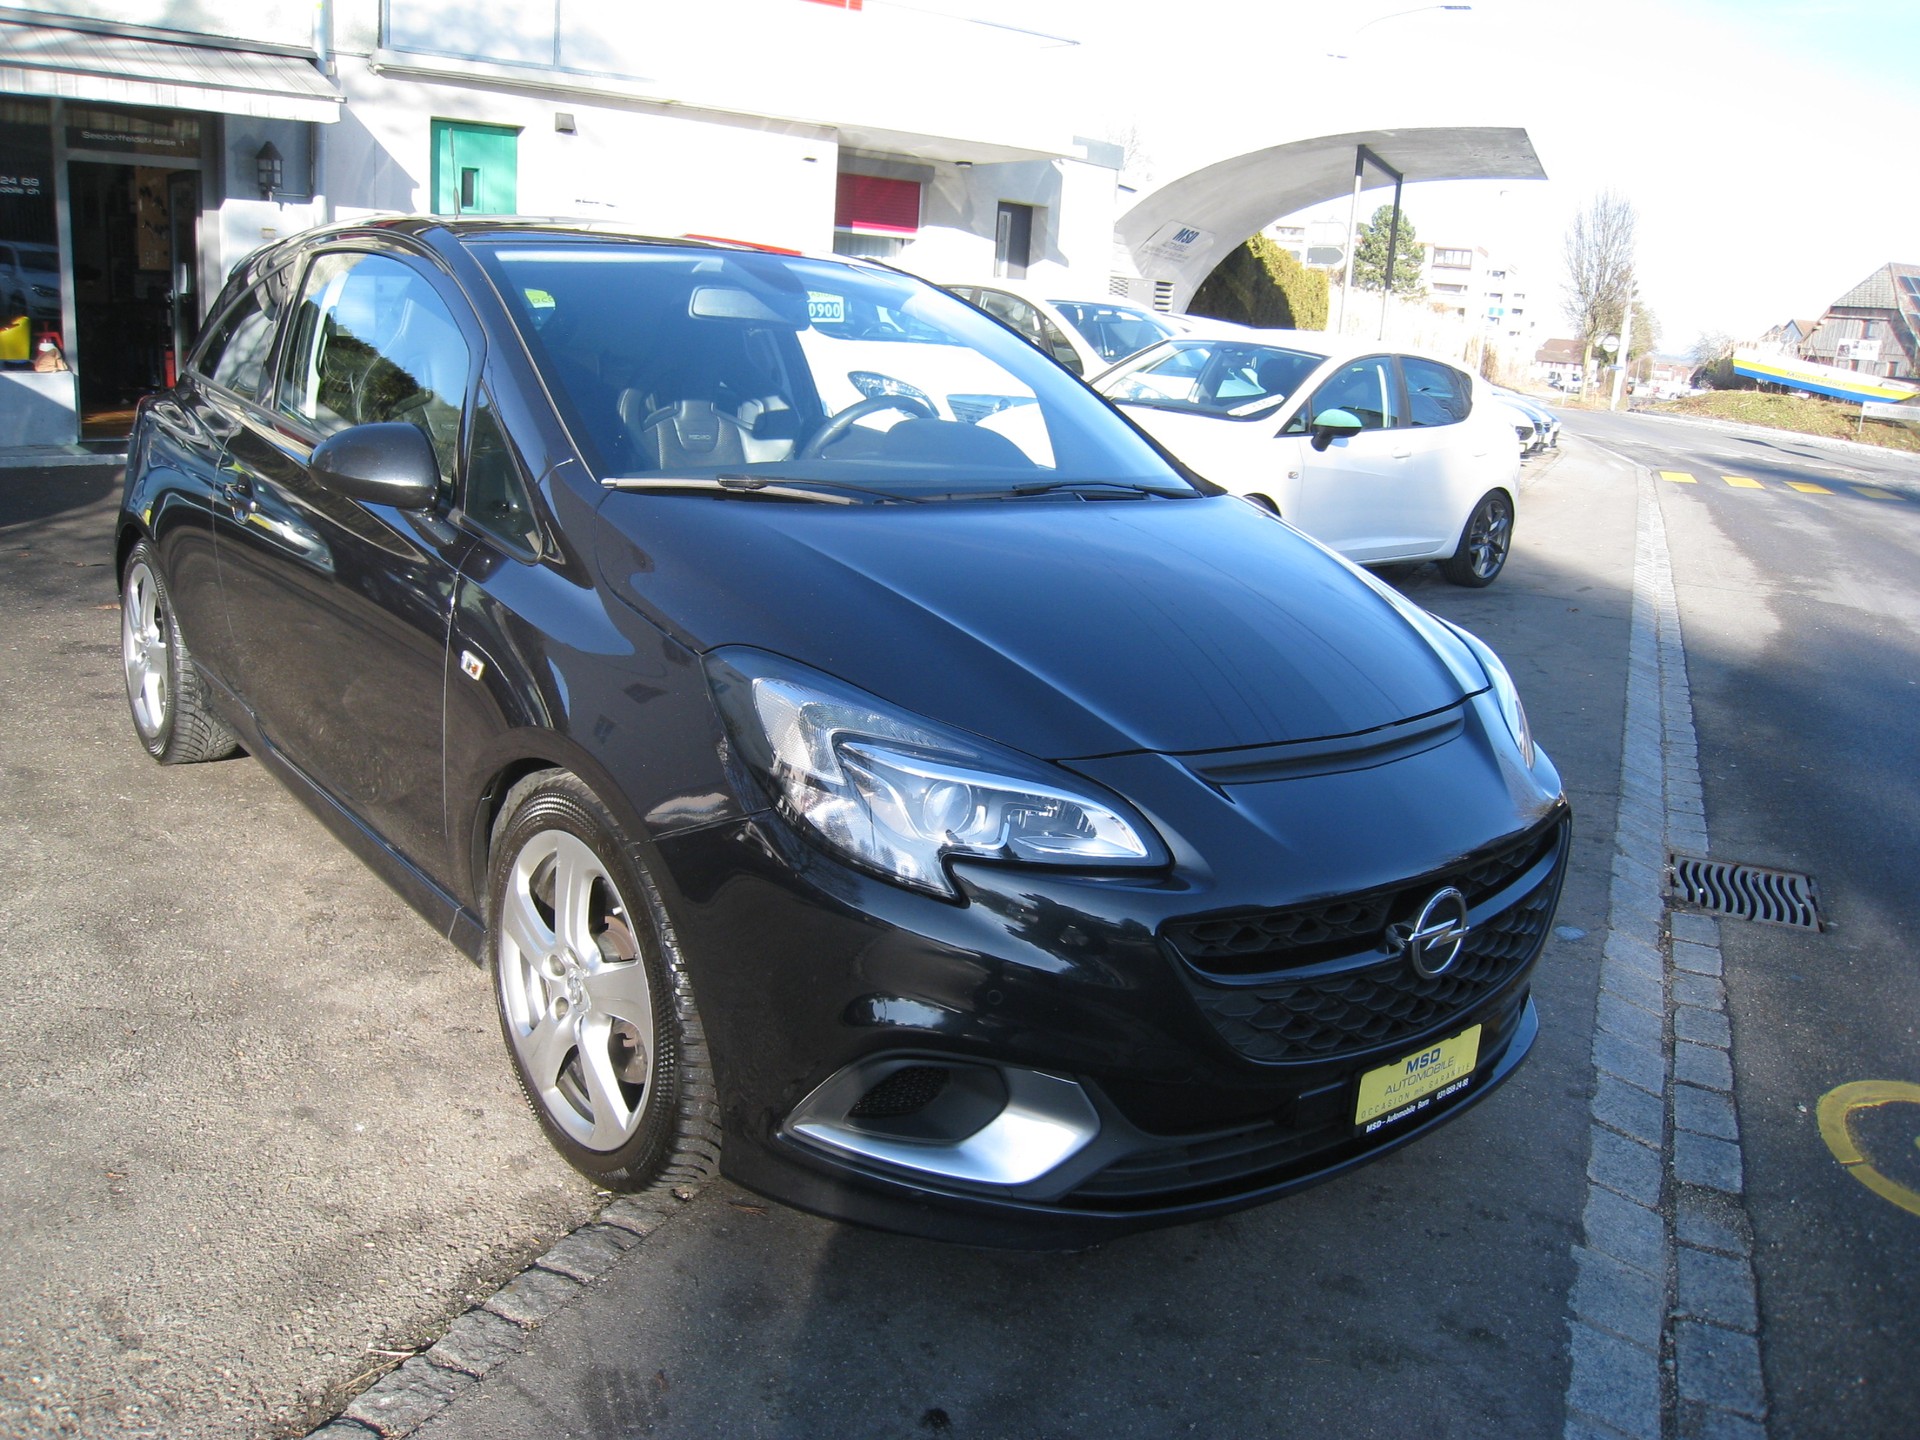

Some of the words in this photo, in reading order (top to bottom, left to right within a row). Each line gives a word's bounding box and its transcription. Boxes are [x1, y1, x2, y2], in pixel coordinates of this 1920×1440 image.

[1172, 228, 1200, 244] MSD
[1405, 1047, 1441, 1075] MSD
[1384, 1056, 1455, 1097] AUTOMOBILE
[1361, 1092, 1410, 1119] OCCASION
